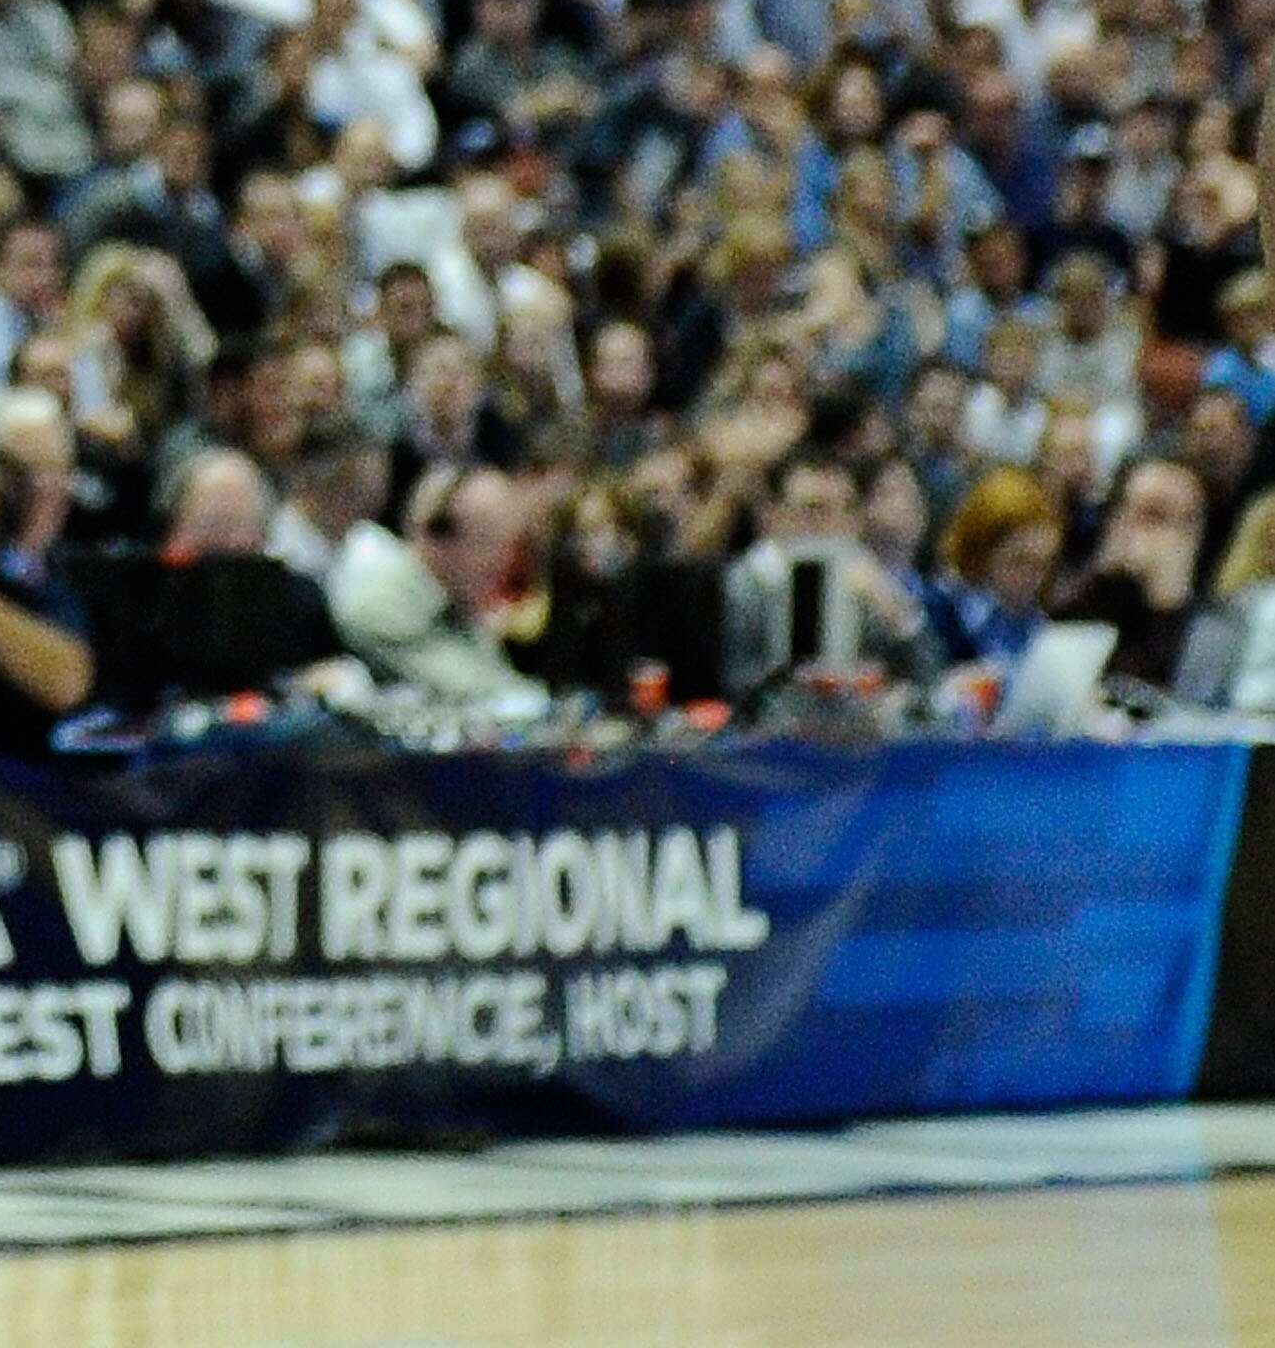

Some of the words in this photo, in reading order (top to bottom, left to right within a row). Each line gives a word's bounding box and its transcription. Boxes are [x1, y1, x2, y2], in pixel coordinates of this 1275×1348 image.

[51, 830, 310, 966] WEST
[318, 824, 772, 962] REGIONAL
[143, 971, 563, 1080] CONFERENCE,
[563, 962, 728, 1060] HOST
